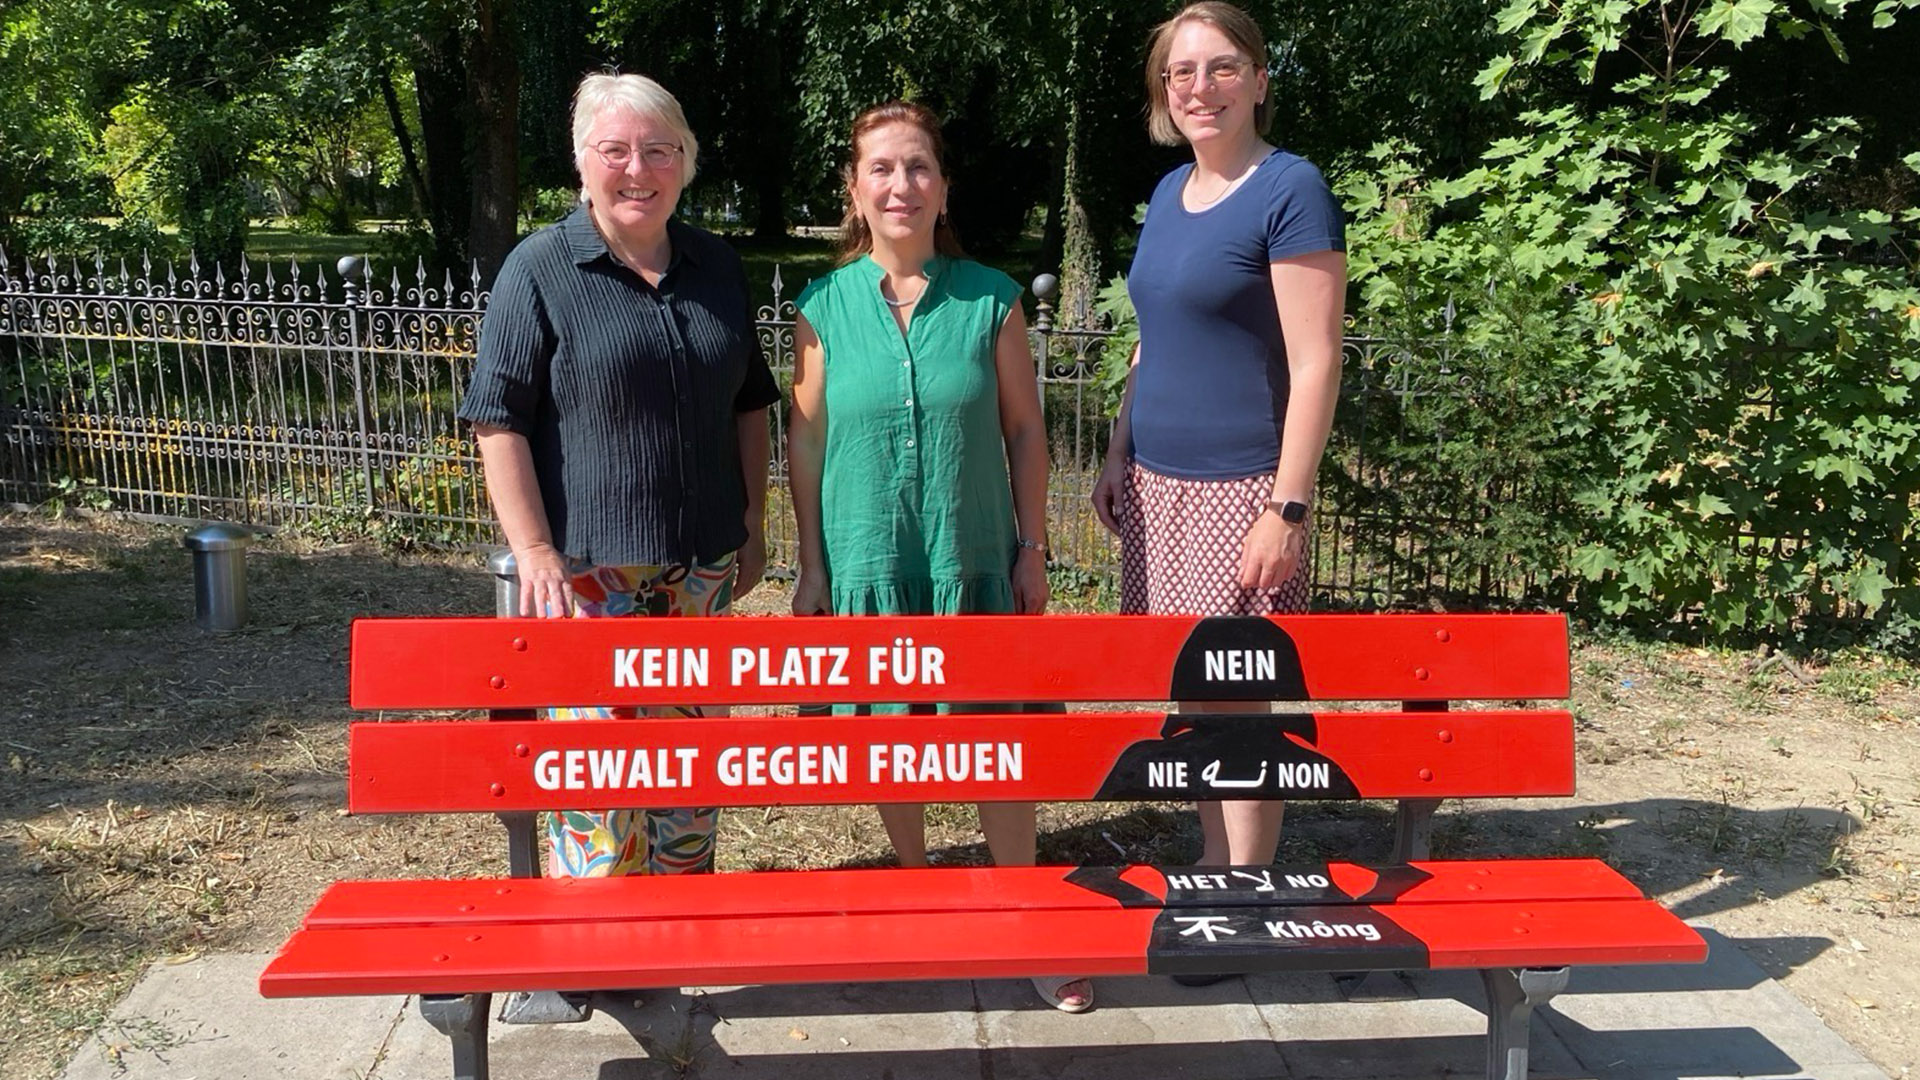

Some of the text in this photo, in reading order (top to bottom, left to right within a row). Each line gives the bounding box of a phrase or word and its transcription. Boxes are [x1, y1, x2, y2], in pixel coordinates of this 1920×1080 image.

[614, 637, 946, 688] KEIN PLATZ FÜR
[1205, 649, 1276, 681] NEIN
[533, 742, 1023, 791] GEWALT GEGEN FRAUEN
[1148, 761, 1188, 788] NIE
[1278, 762, 1329, 789] NON
[1284, 874, 1329, 889] NO
[1173, 915, 1238, 943] 不
[1264, 920, 1382, 941] Không
